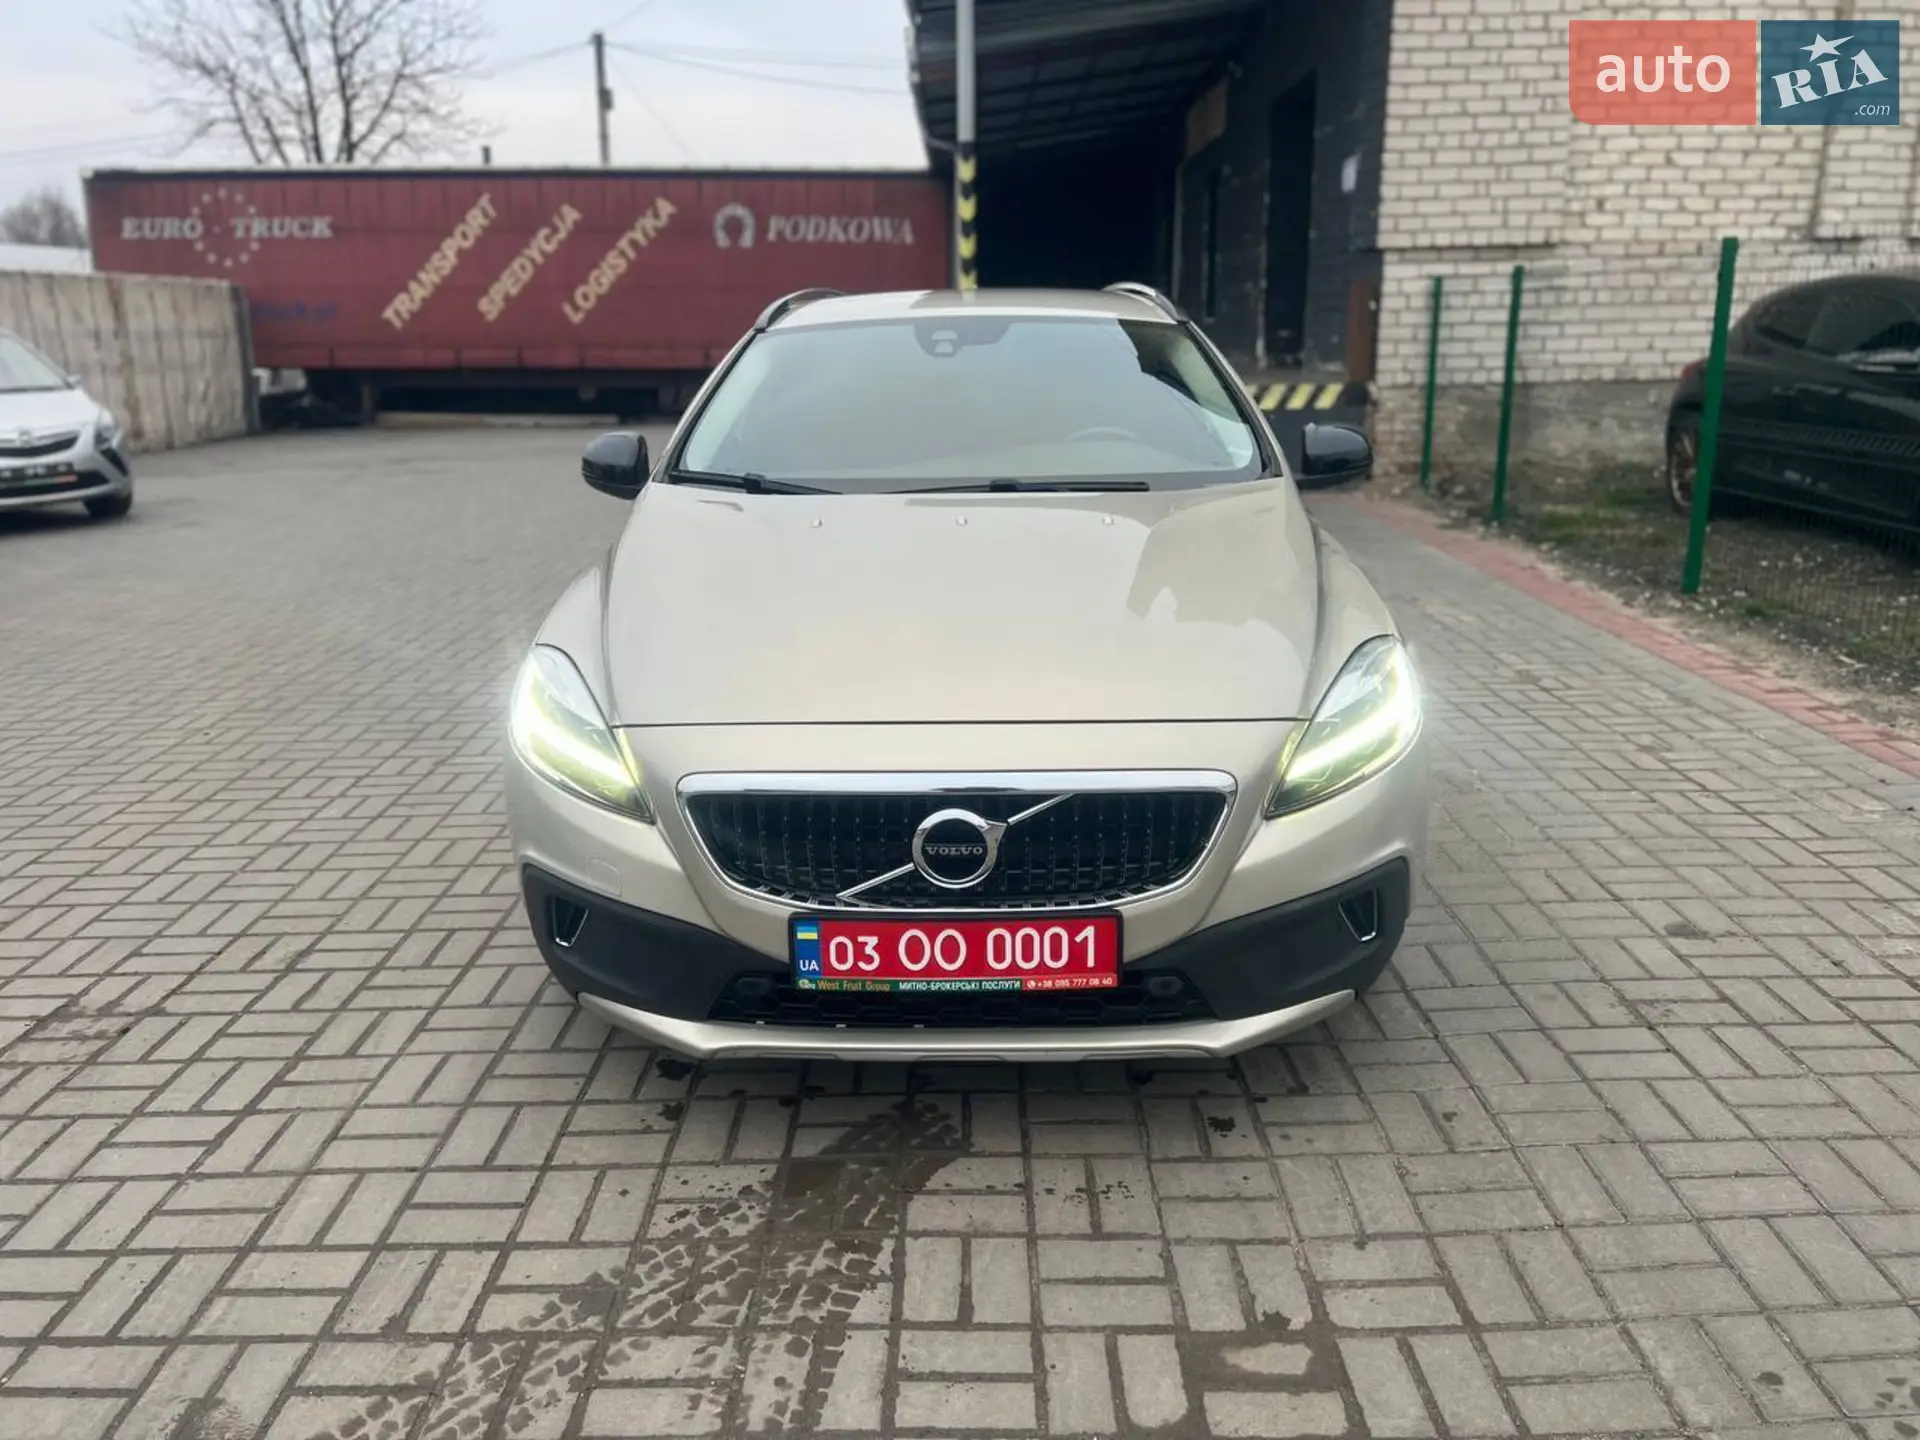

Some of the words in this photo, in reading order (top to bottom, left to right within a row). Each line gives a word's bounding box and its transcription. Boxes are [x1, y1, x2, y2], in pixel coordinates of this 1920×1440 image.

[121, 216, 203, 240] EURO
[230, 214, 334, 239] TRUCK
[767, 214, 915, 245] PODKOWA
[381, 192, 497, 330] TRANSPORT
[477, 203, 583, 322] SPEDYCJA
[562, 196, 678, 325] LOGISTYKA
[924, 846, 984, 856] VOLVO
[829, 935, 881, 972] 03
[986, 925, 1095, 970] 0001
[799, 959, 820, 972] UA
[817, 979, 840, 990] West
[843, 979, 862, 990] Fruit
[865, 980, 890, 992] Group
[899, 981, 979, 991] МИТНО-БРОКЕРСЬКІ
[981, 980, 1021, 990] ПОСЛУГИ
[1072, 978, 1087, 987] 777
